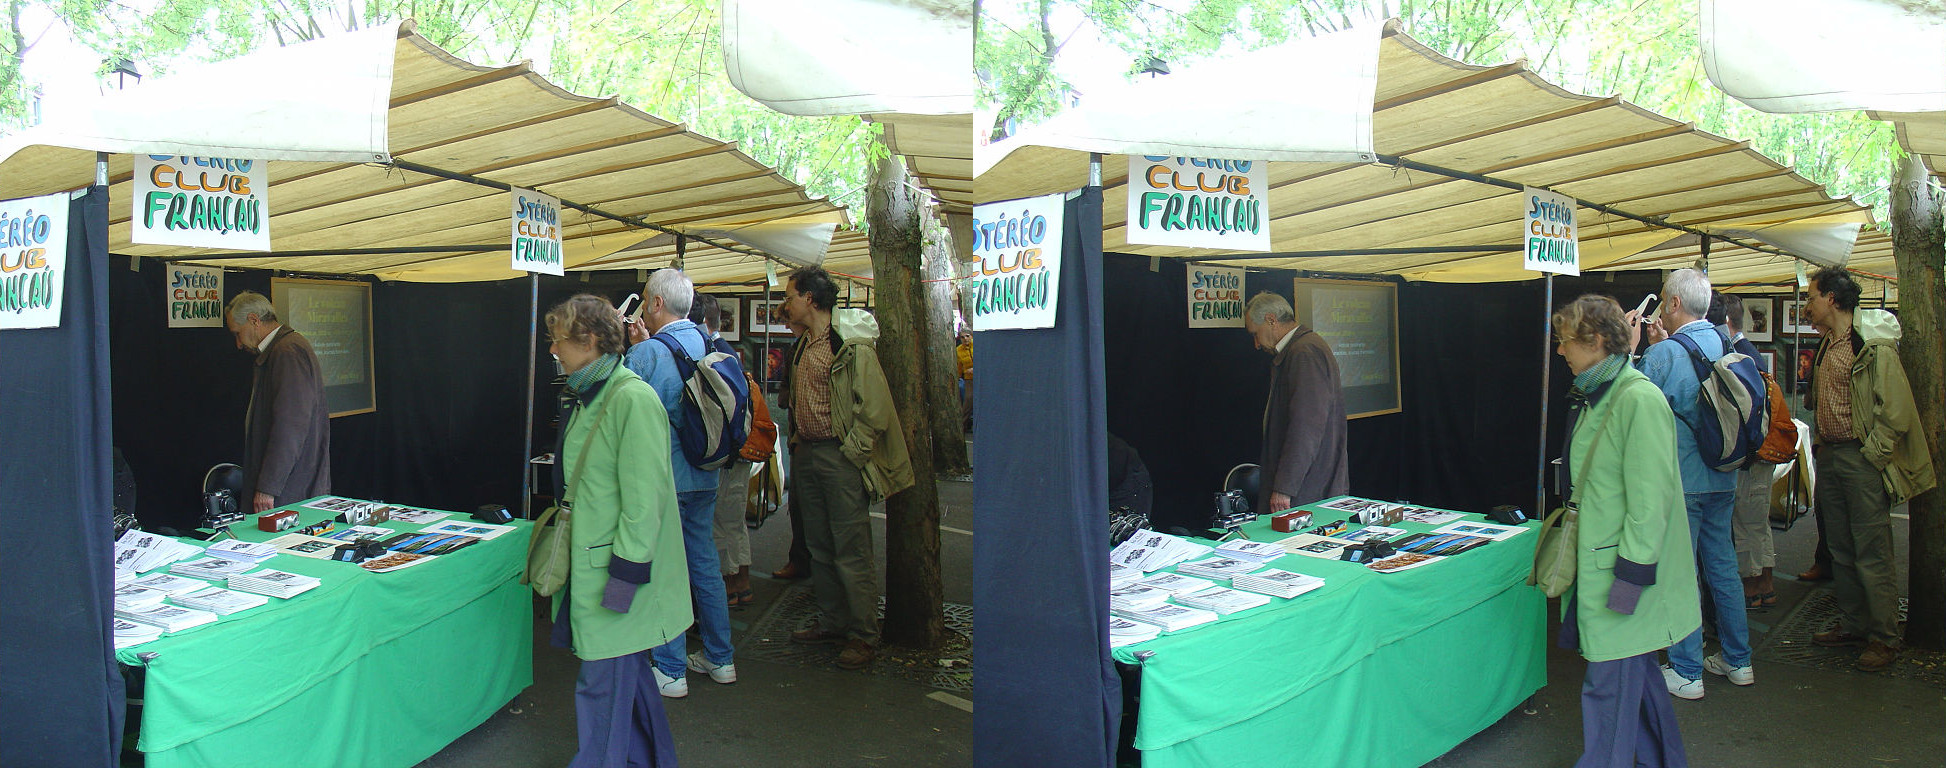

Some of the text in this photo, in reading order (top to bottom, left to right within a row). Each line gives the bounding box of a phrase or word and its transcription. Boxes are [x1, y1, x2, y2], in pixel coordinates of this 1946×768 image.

[150, 164, 251, 195] CLUB
[1146, 165, 1250, 196] CLUB
[144, 191, 260, 235] FRANÇAIS
[516, 196, 556, 226] STÉRÉO
[1139, 191, 1260, 235] FRANÇAIS
[1529, 195, 1572, 226] STÉRÉO
[518, 220, 556, 240] CLUB
[1531, 220, 1571, 240] CLUB
[0, 248, 47, 273] UB
[516, 237, 560, 266] FRANÇAIS
[1529, 237, 1575, 266] FRANÇAIS
[172, 270, 218, 289] STÉRÉO
[973, 265, 1050, 317] RANÇAIS
[1192, 270, 1239, 289] STÉRÉO
[173, 289, 219, 300] CLUB
[1194, 289, 1239, 300] CLUB
